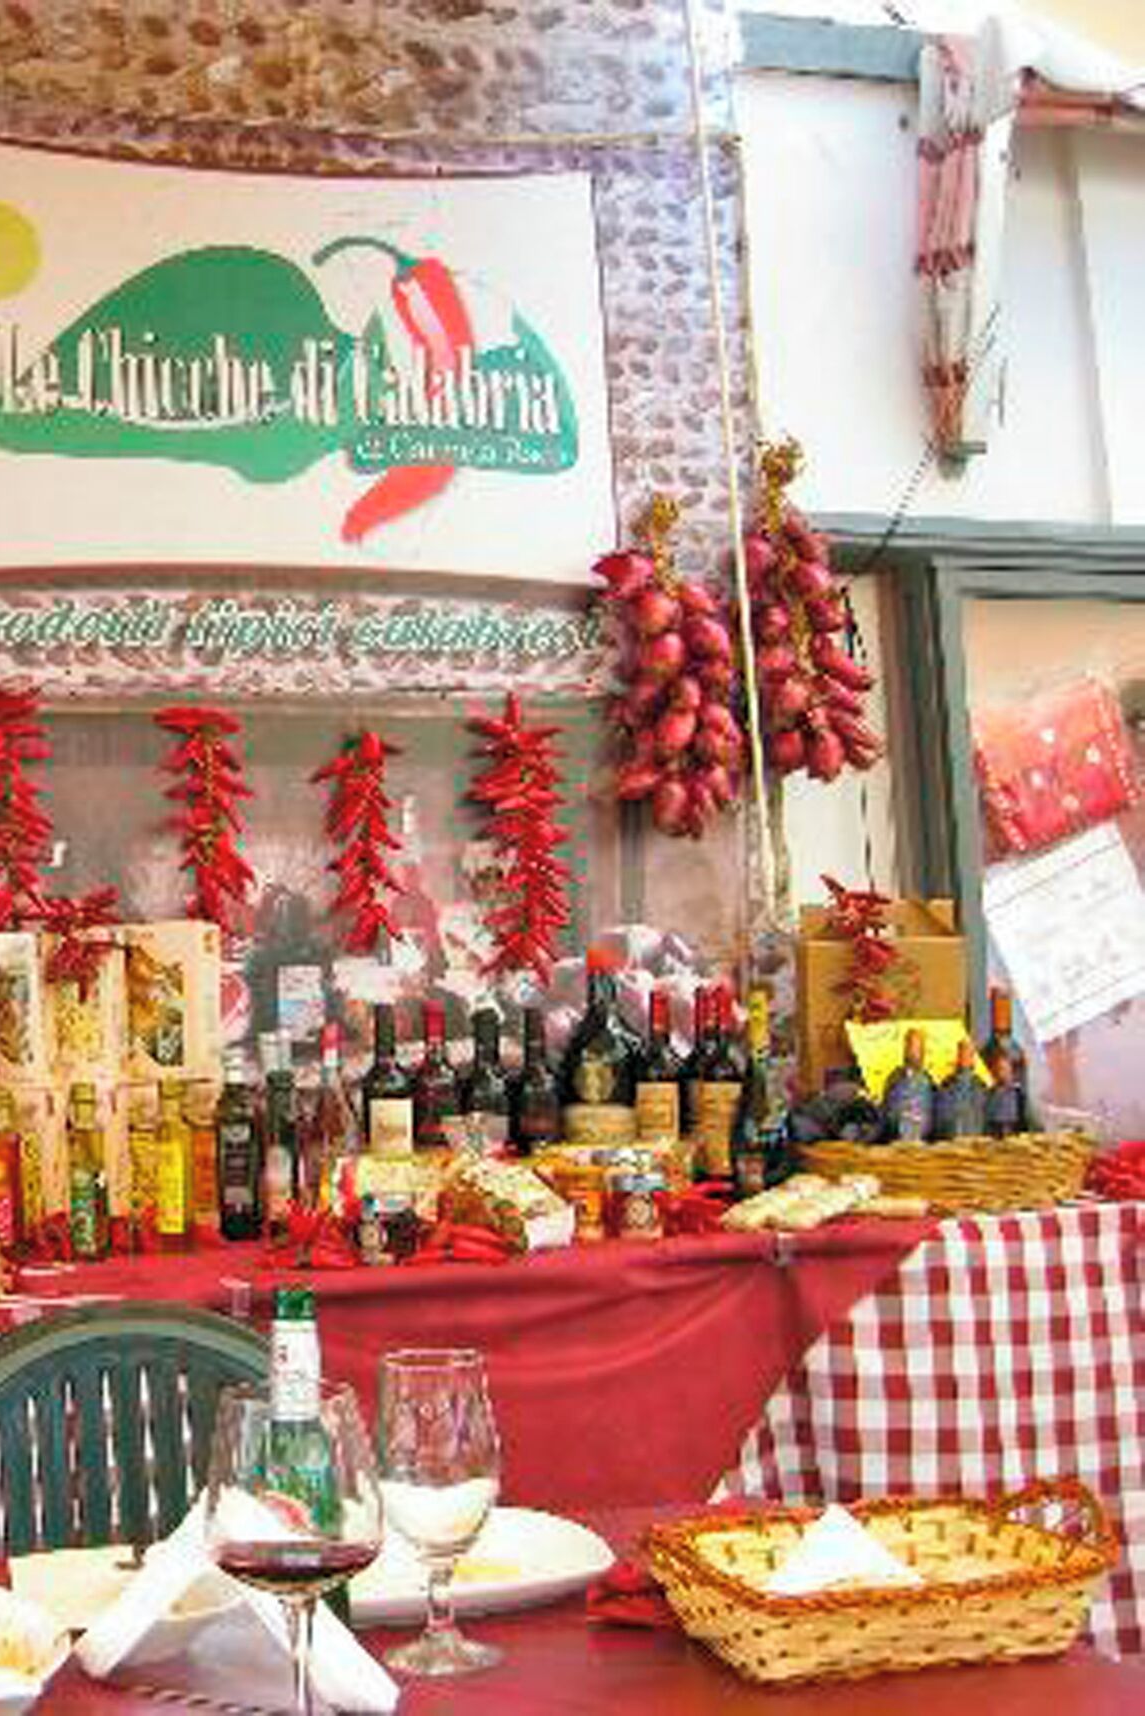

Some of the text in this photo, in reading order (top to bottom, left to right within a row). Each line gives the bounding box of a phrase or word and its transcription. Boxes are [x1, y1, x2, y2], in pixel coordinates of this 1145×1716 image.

[77, 326, 276, 428] Chicche
[291, 338, 338, 425] di
[349, 342, 560, 434] Calabria
[185, 599, 338, 655] tipici
[352, 601, 598, 651] calabresi
